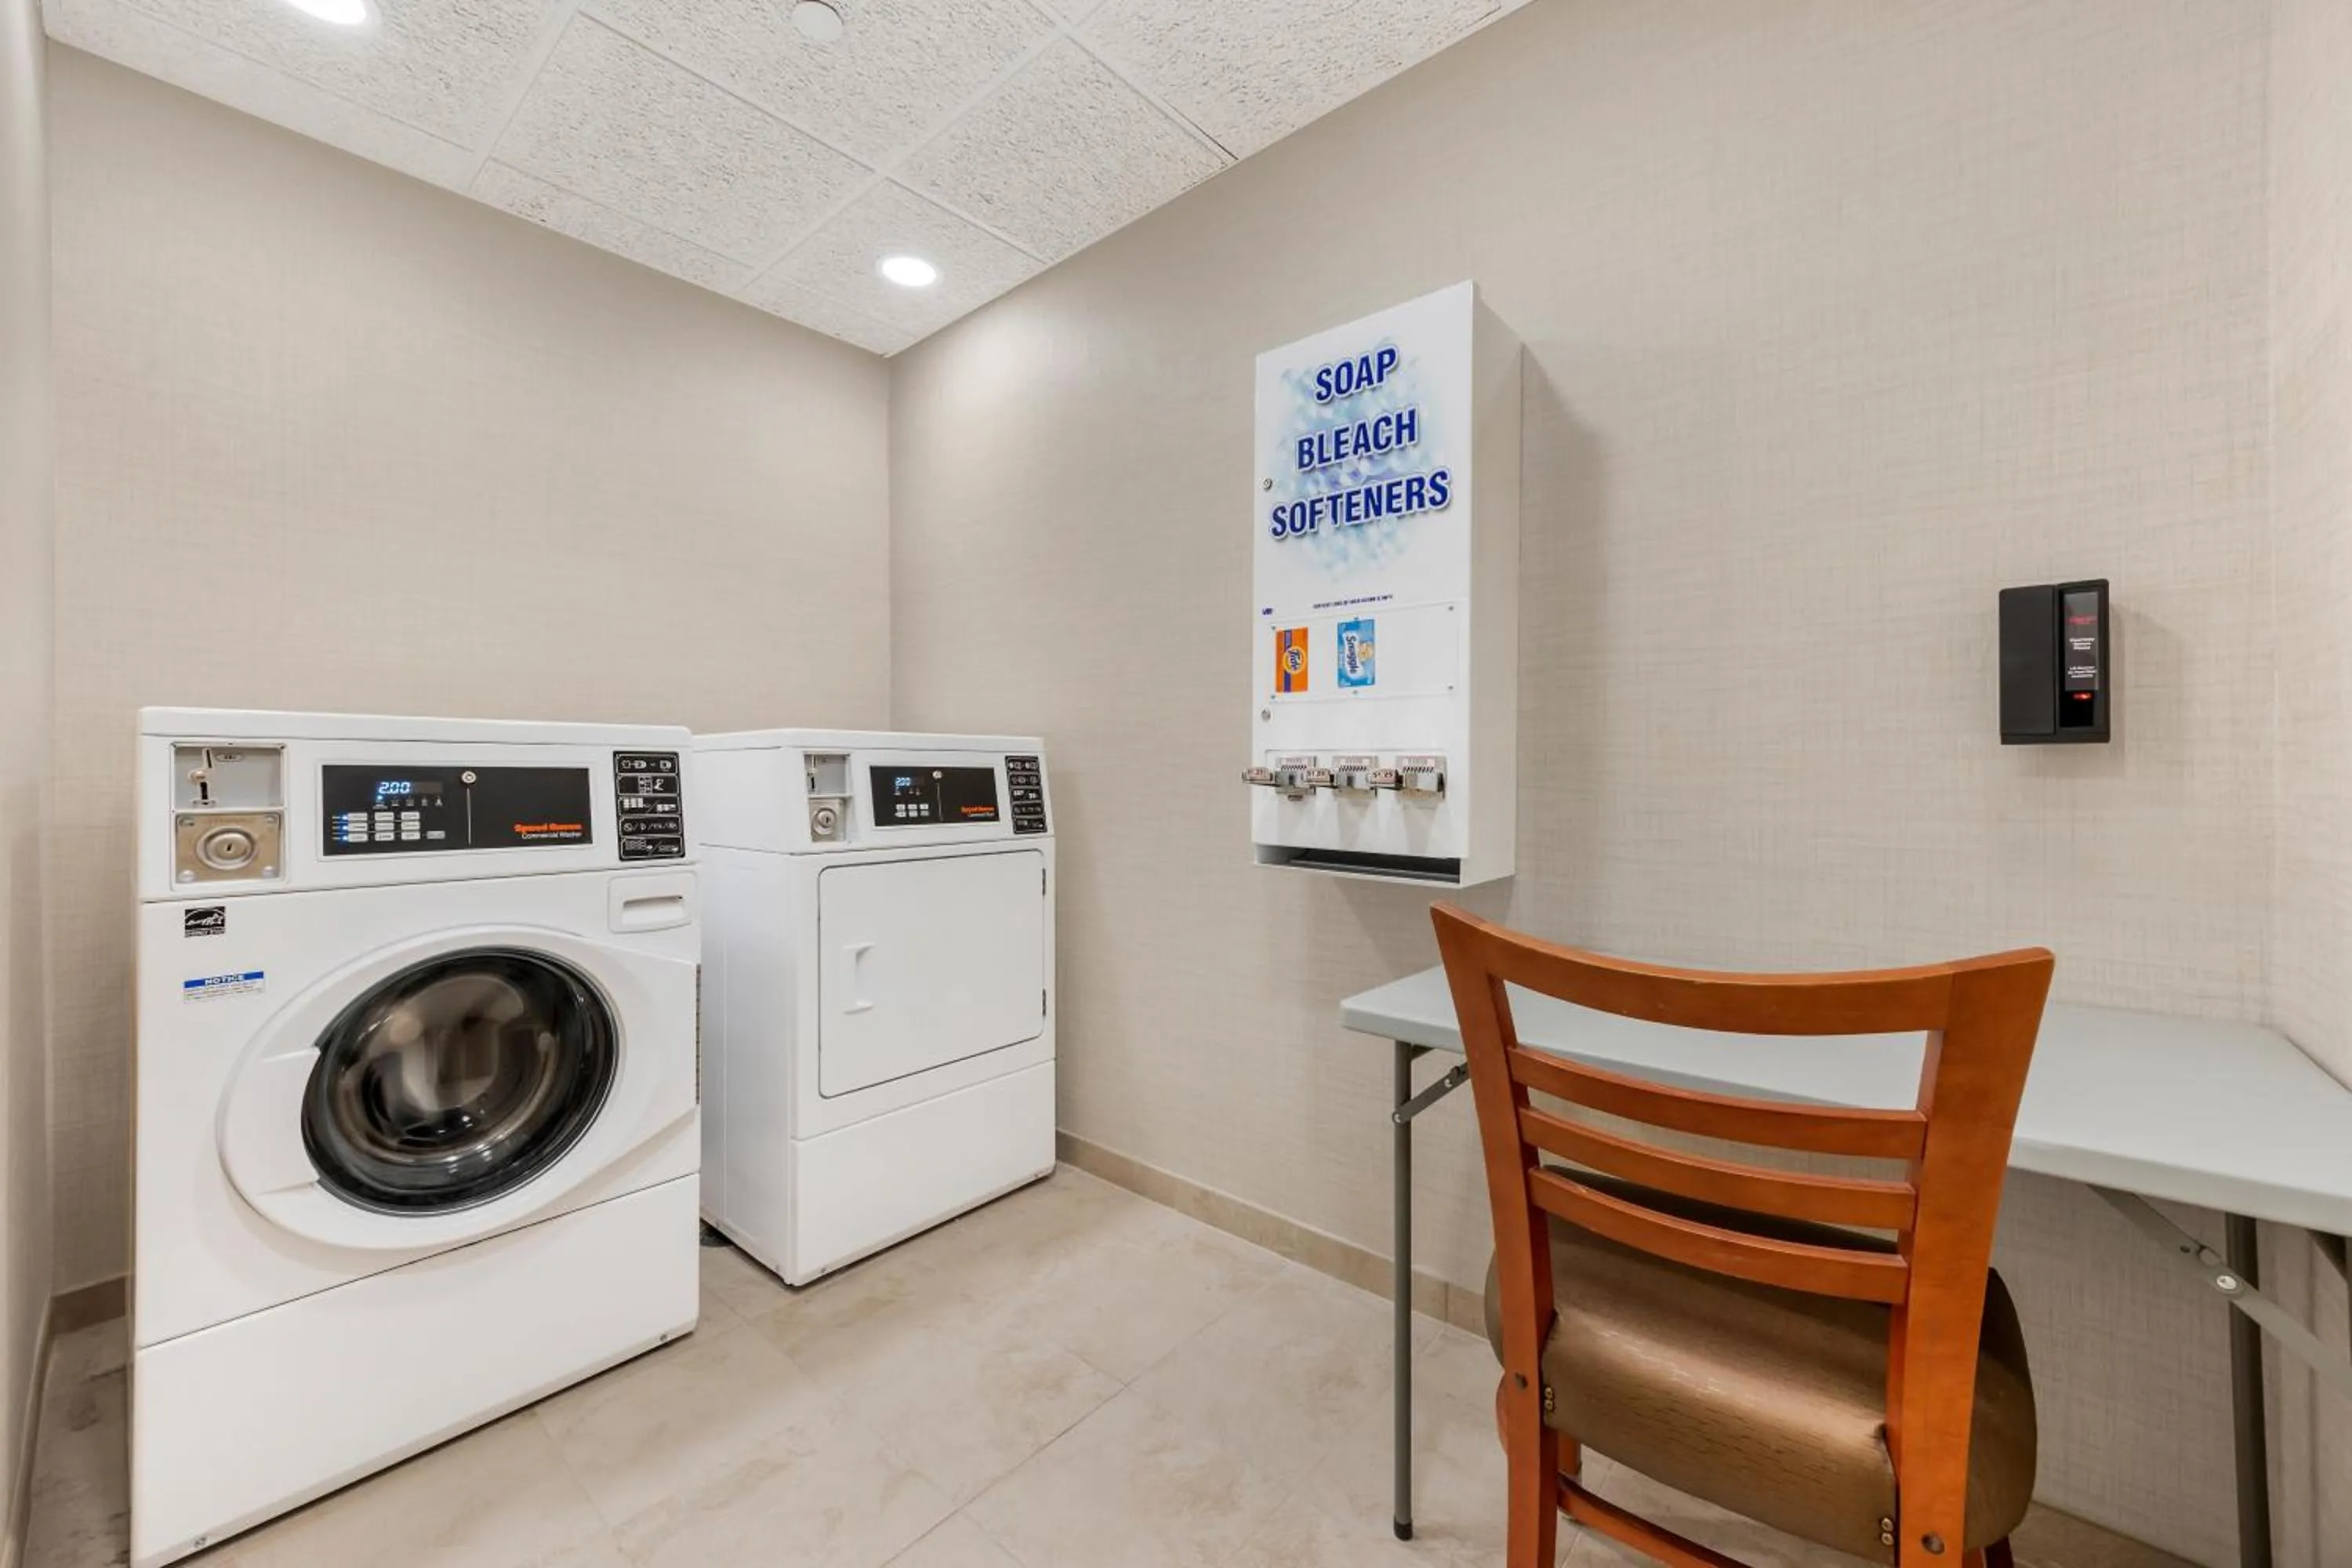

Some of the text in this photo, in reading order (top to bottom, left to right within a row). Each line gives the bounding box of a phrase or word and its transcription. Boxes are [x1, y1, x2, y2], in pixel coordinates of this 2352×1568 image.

[1315, 347, 1397, 402] SOAP
[1298, 408, 1417, 470] BLEACH
[1270, 470, 1449, 537] SOFTENERS
[1346, 635, 1359, 674] Snuggle
[205, 975, 245, 985] NOTICE
